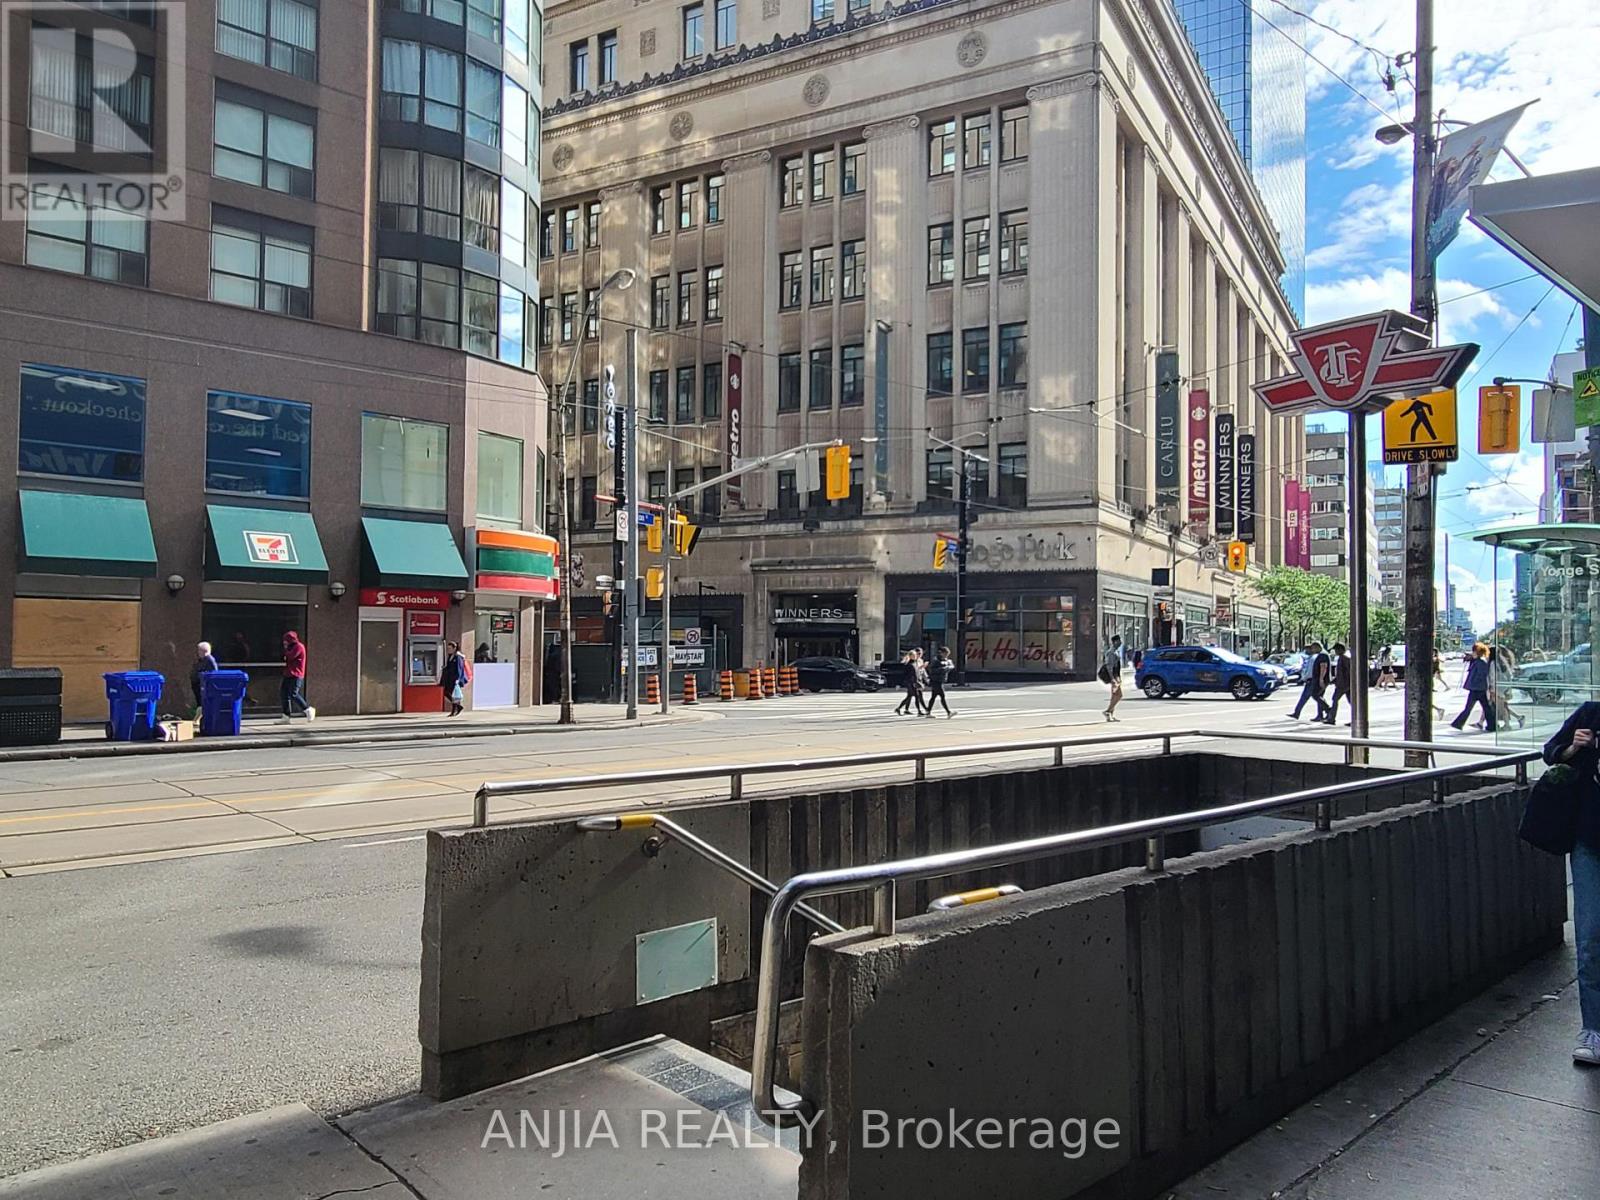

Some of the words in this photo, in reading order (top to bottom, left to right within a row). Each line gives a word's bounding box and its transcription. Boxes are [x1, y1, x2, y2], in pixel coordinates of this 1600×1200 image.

[1160, 416, 1174, 477] CARLU
[1385, 451, 1413, 462] DRIVE
[1419, 448, 1456, 460] SLOWLY
[1193, 438, 1206, 497] metro
[1219, 422, 1231, 508] WINNERS
[1241, 442, 1251, 521] WINNERS
[1541, 565, 1584, 578] Yonge
[389, 594, 439, 605] Scotiabank
[775, 608, 843, 618] WINNERS
[992, 637, 1065, 662] Hotons
